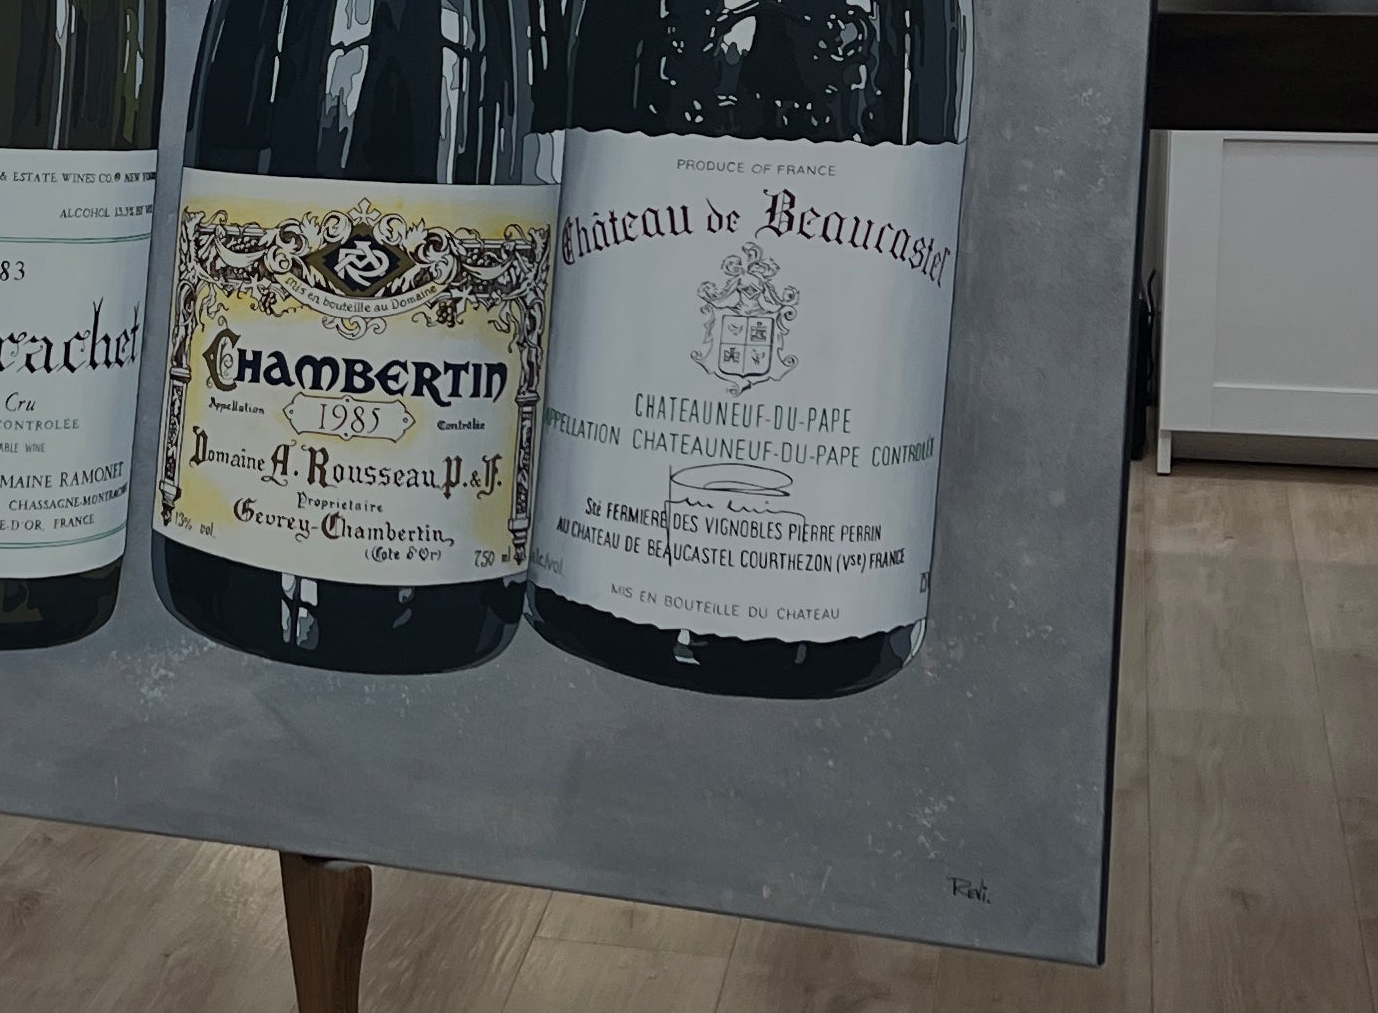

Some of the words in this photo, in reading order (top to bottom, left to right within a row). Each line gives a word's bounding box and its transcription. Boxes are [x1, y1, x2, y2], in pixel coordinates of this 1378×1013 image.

[0, 170, 8, 181] &
[13, 171, 58, 183] ESTATE
[62, 172, 96, 184] WINES
[677, 158, 746, 173] PRODUCE
[752, 163, 773, 175] OF
[776, 164, 837, 177] FRANCE
[59, 206, 111, 219] ALCOHOL
[706, 198, 741, 234] de
[755, 188, 952, 289] Beaucastel
[307, 291, 321, 305] en
[323, 298, 372, 314] bouteille
[373, 303, 389, 313] au
[391, 284, 438, 310] Domaine
[5, 391, 37, 412] Cru
[209, 396, 265, 415] Appellation
[635, 393, 852, 434] CHATEAUNEUF-DU-PAPE
[318, 403, 380, 435] 1985
[25, 442, 46, 454] WINE
[189, 426, 265, 472] Domaine
[301, 444, 438, 489] Rousseau
[632, 428, 860, 468] CHATEAUNEUF-DU-PAPE
[59, 460, 125, 489] RAMONET
[53, 513, 95, 530] FRANCE
[174, 511, 193, 531] 13%
[607, 502, 669, 530] FERMIERE
[673, 512, 699, 534] DES
[706, 516, 782, 541] VIGNOBLES
[788, 521, 835, 542] PIERRE
[840, 521, 882, 543] PERRIN
[474, 550, 496, 568] 750
[556, 516, 570, 534] AU
[571, 520, 620, 549] CHATEAU
[625, 535, 640, 554] DE
[647, 539, 734, 569] BEAUCASTEL
[740, 550, 833, 573] COURTHEZON
[869, 547, 906, 572] FRANCE
[611, 582, 633, 599] MIS
[639, 590, 658, 603] EN
[664, 595, 741, 618] BOUTEILLE
[748, 606, 768, 620] DU
[776, 606, 841, 622] CHATEAU
